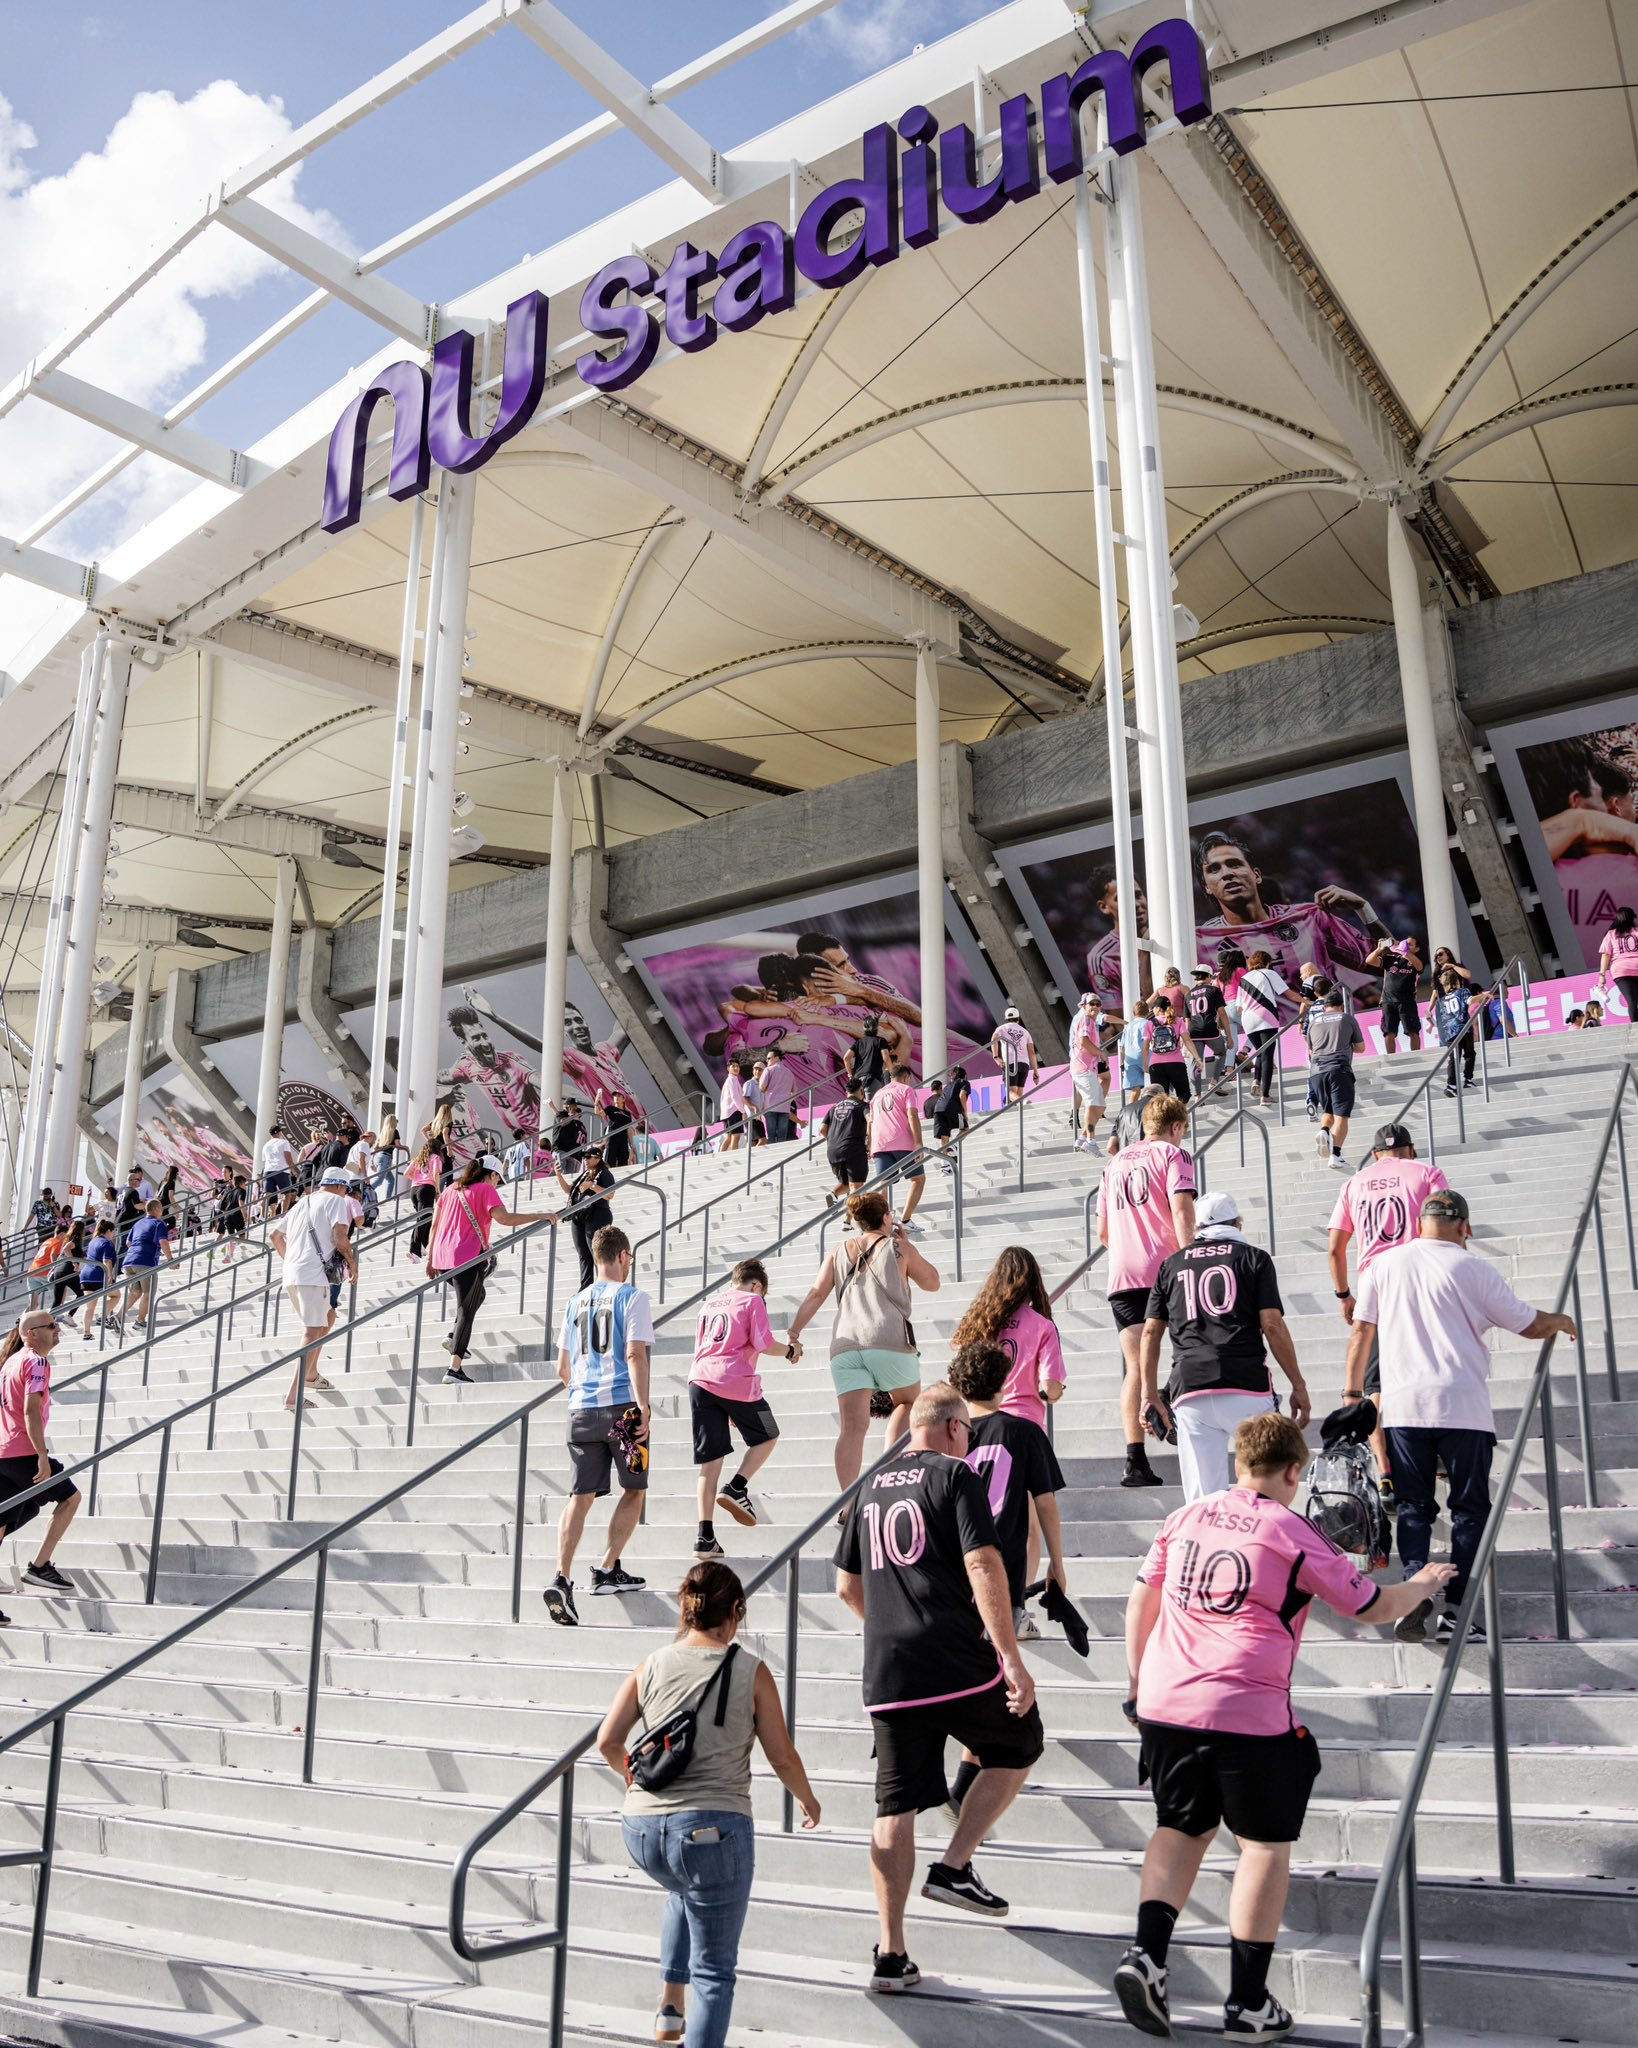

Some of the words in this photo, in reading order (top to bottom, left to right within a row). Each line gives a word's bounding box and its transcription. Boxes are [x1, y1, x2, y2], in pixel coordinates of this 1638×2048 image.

[576, 18, 1212, 392] Stadium
[1189, 996, 1208, 1018] 10
[1444, 998, 1460, 1014] 10
[291, 1105, 322, 1118] MIAMI
[327, 1098, 340, 1110] DE
[576, 1131, 586, 1145] 10
[1119, 1149, 1151, 1161] MESSI
[1112, 1166, 1150, 1211] 10
[1360, 1176, 1400, 1191] MESSI
[1357, 1195, 1406, 1245] 10
[1184, 1244, 1232, 1260] MESSI
[580, 1297, 613, 1308] MESSI
[1177, 1264, 1237, 1320] 10
[708, 1299, 732, 1308] MESSI
[574, 1308, 613, 1355] 10
[700, 1313, 728, 1346] 10
[872, 1468, 925, 1489] MESSI
[1197, 1508, 1262, 1535] MESSI
[863, 1498, 926, 1571] 10
[1177, 1537, 1252, 1616] 10
